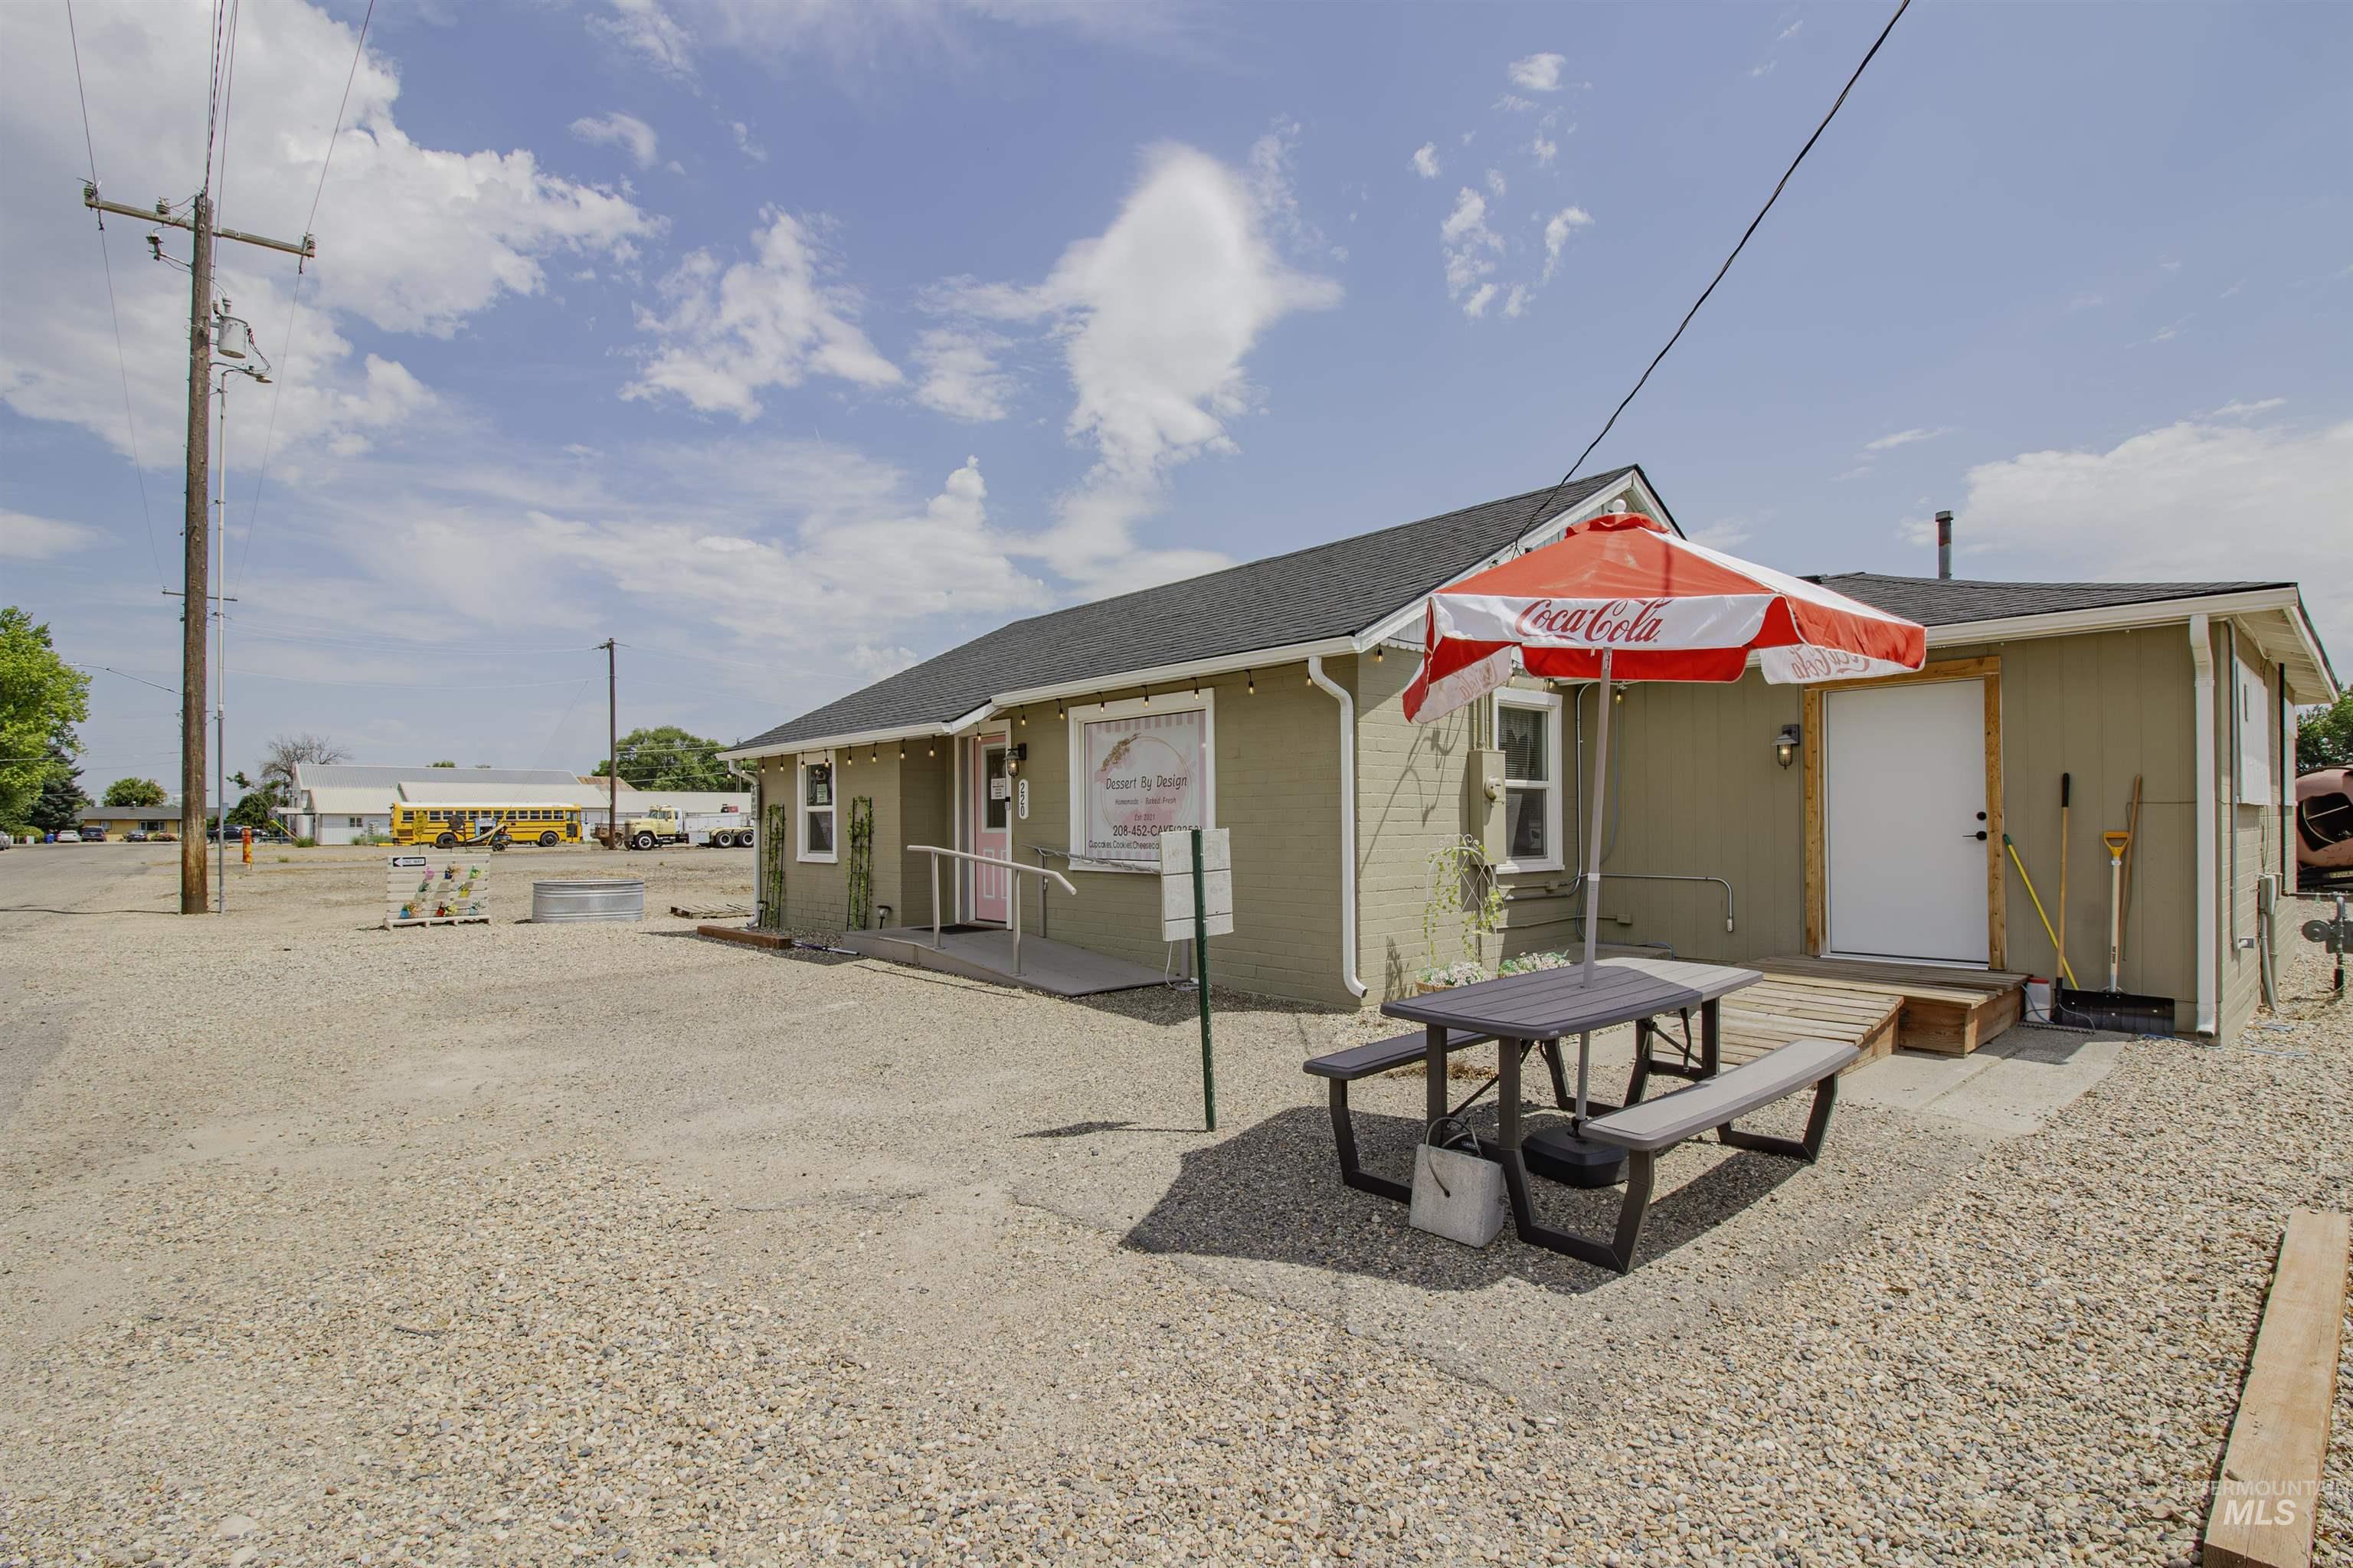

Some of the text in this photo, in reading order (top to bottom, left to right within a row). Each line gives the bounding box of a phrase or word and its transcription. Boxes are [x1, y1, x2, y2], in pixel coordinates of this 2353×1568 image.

[1514, 598, 1673, 643] Coca-Cola
[1106, 774, 1187, 791] Dessert By Design
[1133, 841, 1160, 849] Cheeseca
